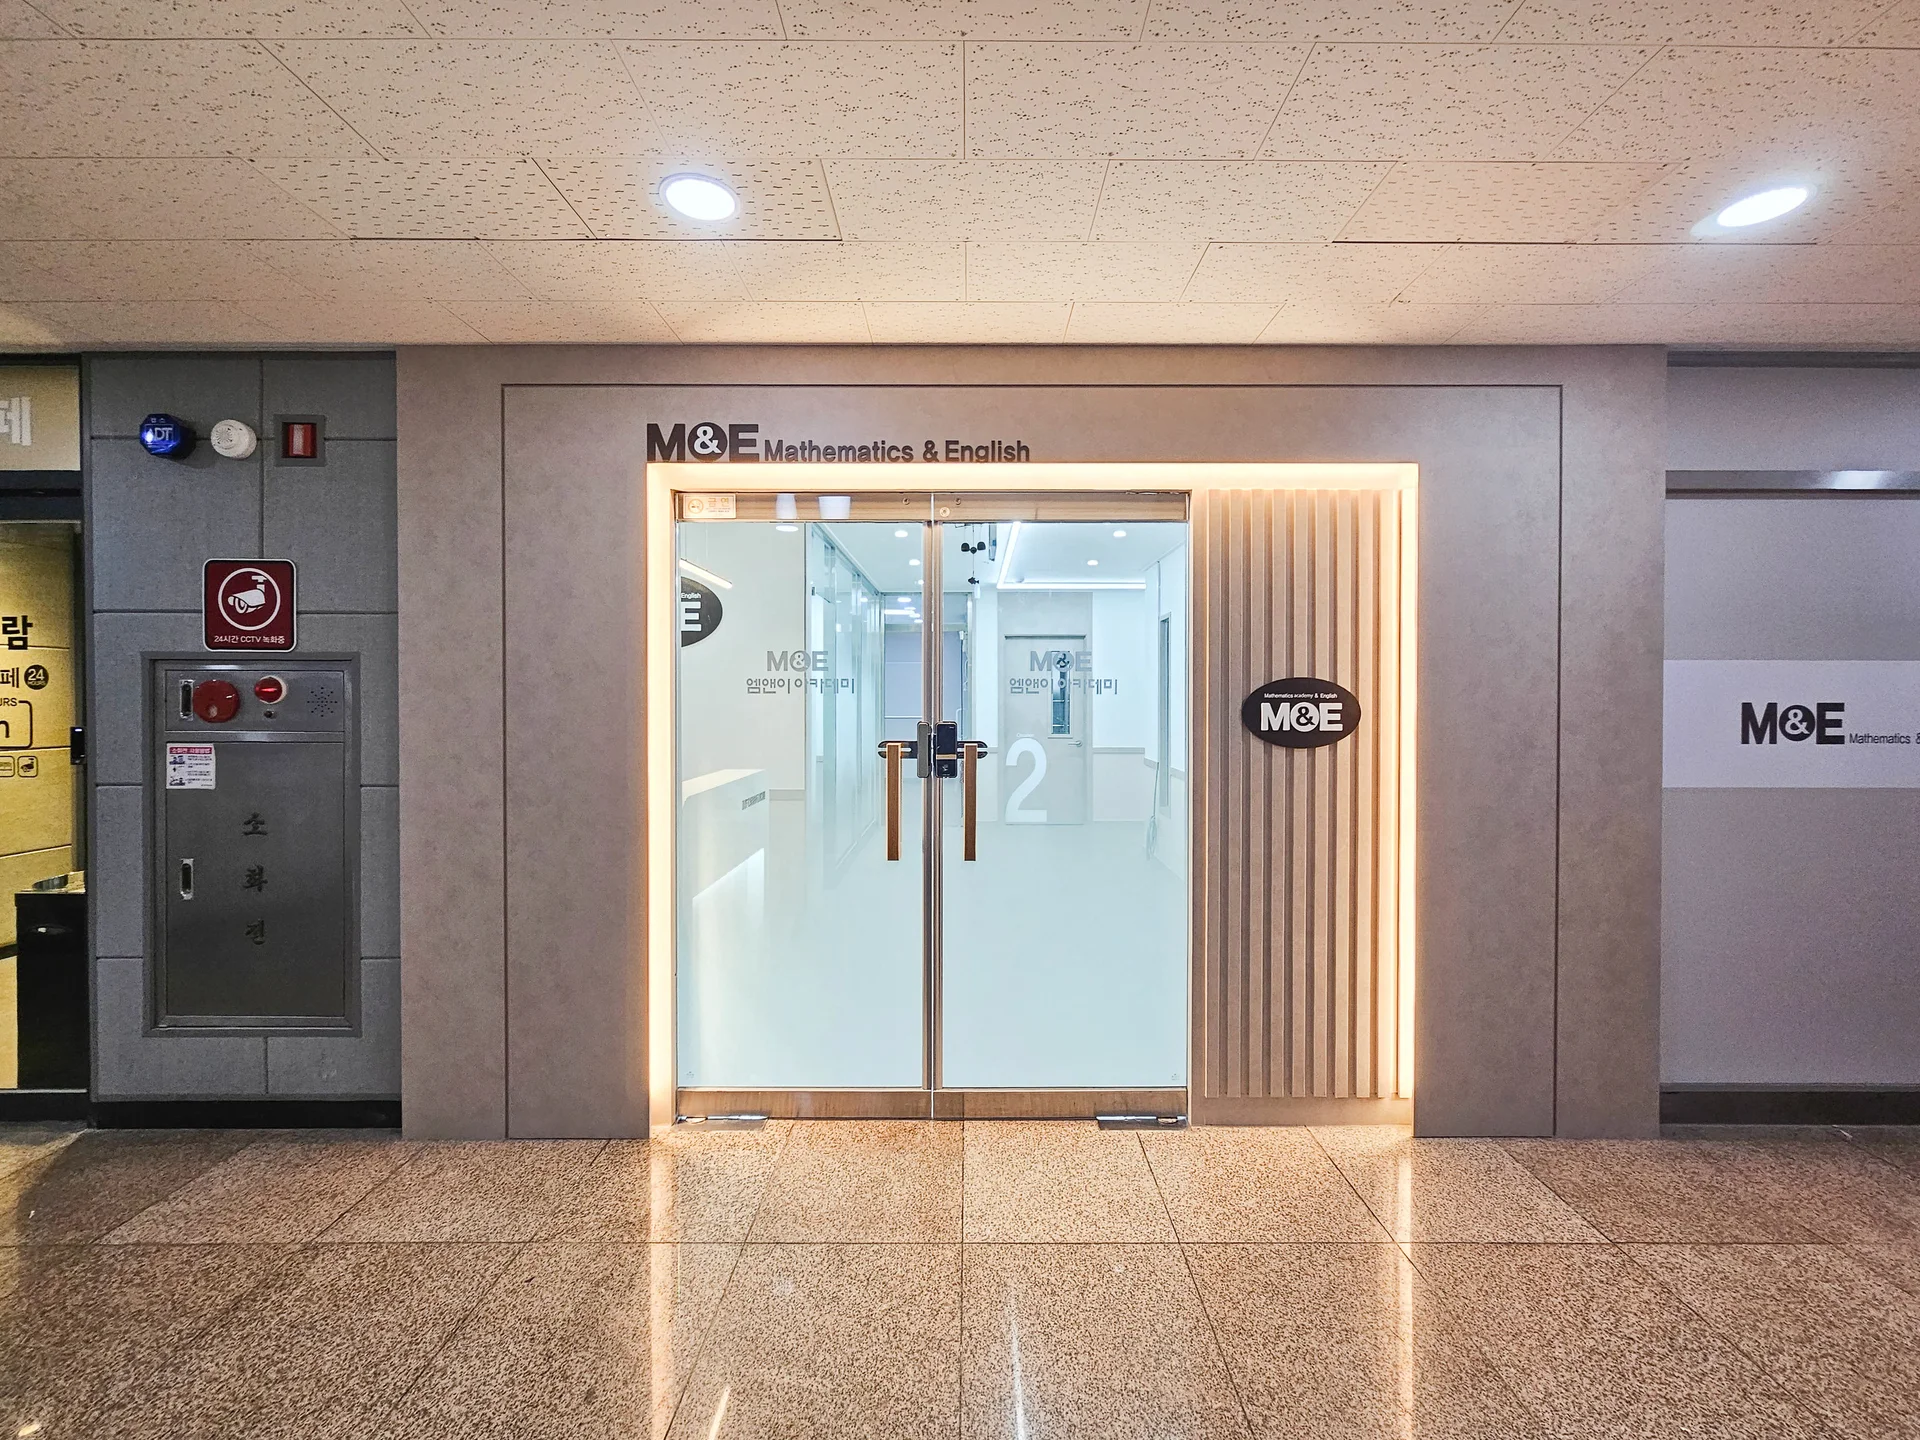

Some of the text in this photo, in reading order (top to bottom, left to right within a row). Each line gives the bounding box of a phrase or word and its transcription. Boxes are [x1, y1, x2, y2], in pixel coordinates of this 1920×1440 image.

[647, 422, 1030, 462] M&E Mathematics & English
[2, 615, 33, 650] 람
[214, 635, 285, 644] 24시간 CCTV 녹화중
[28, 668, 45, 681] 24
[766, 651, 828, 672] M&E
[1030, 651, 1092, 673] M&E
[1261, 702, 1343, 732] M&E
[1741, 702, 1845, 745] M&E
[1849, 732, 1911, 744] Mathematics
[1005, 737, 1047, 822] 2
